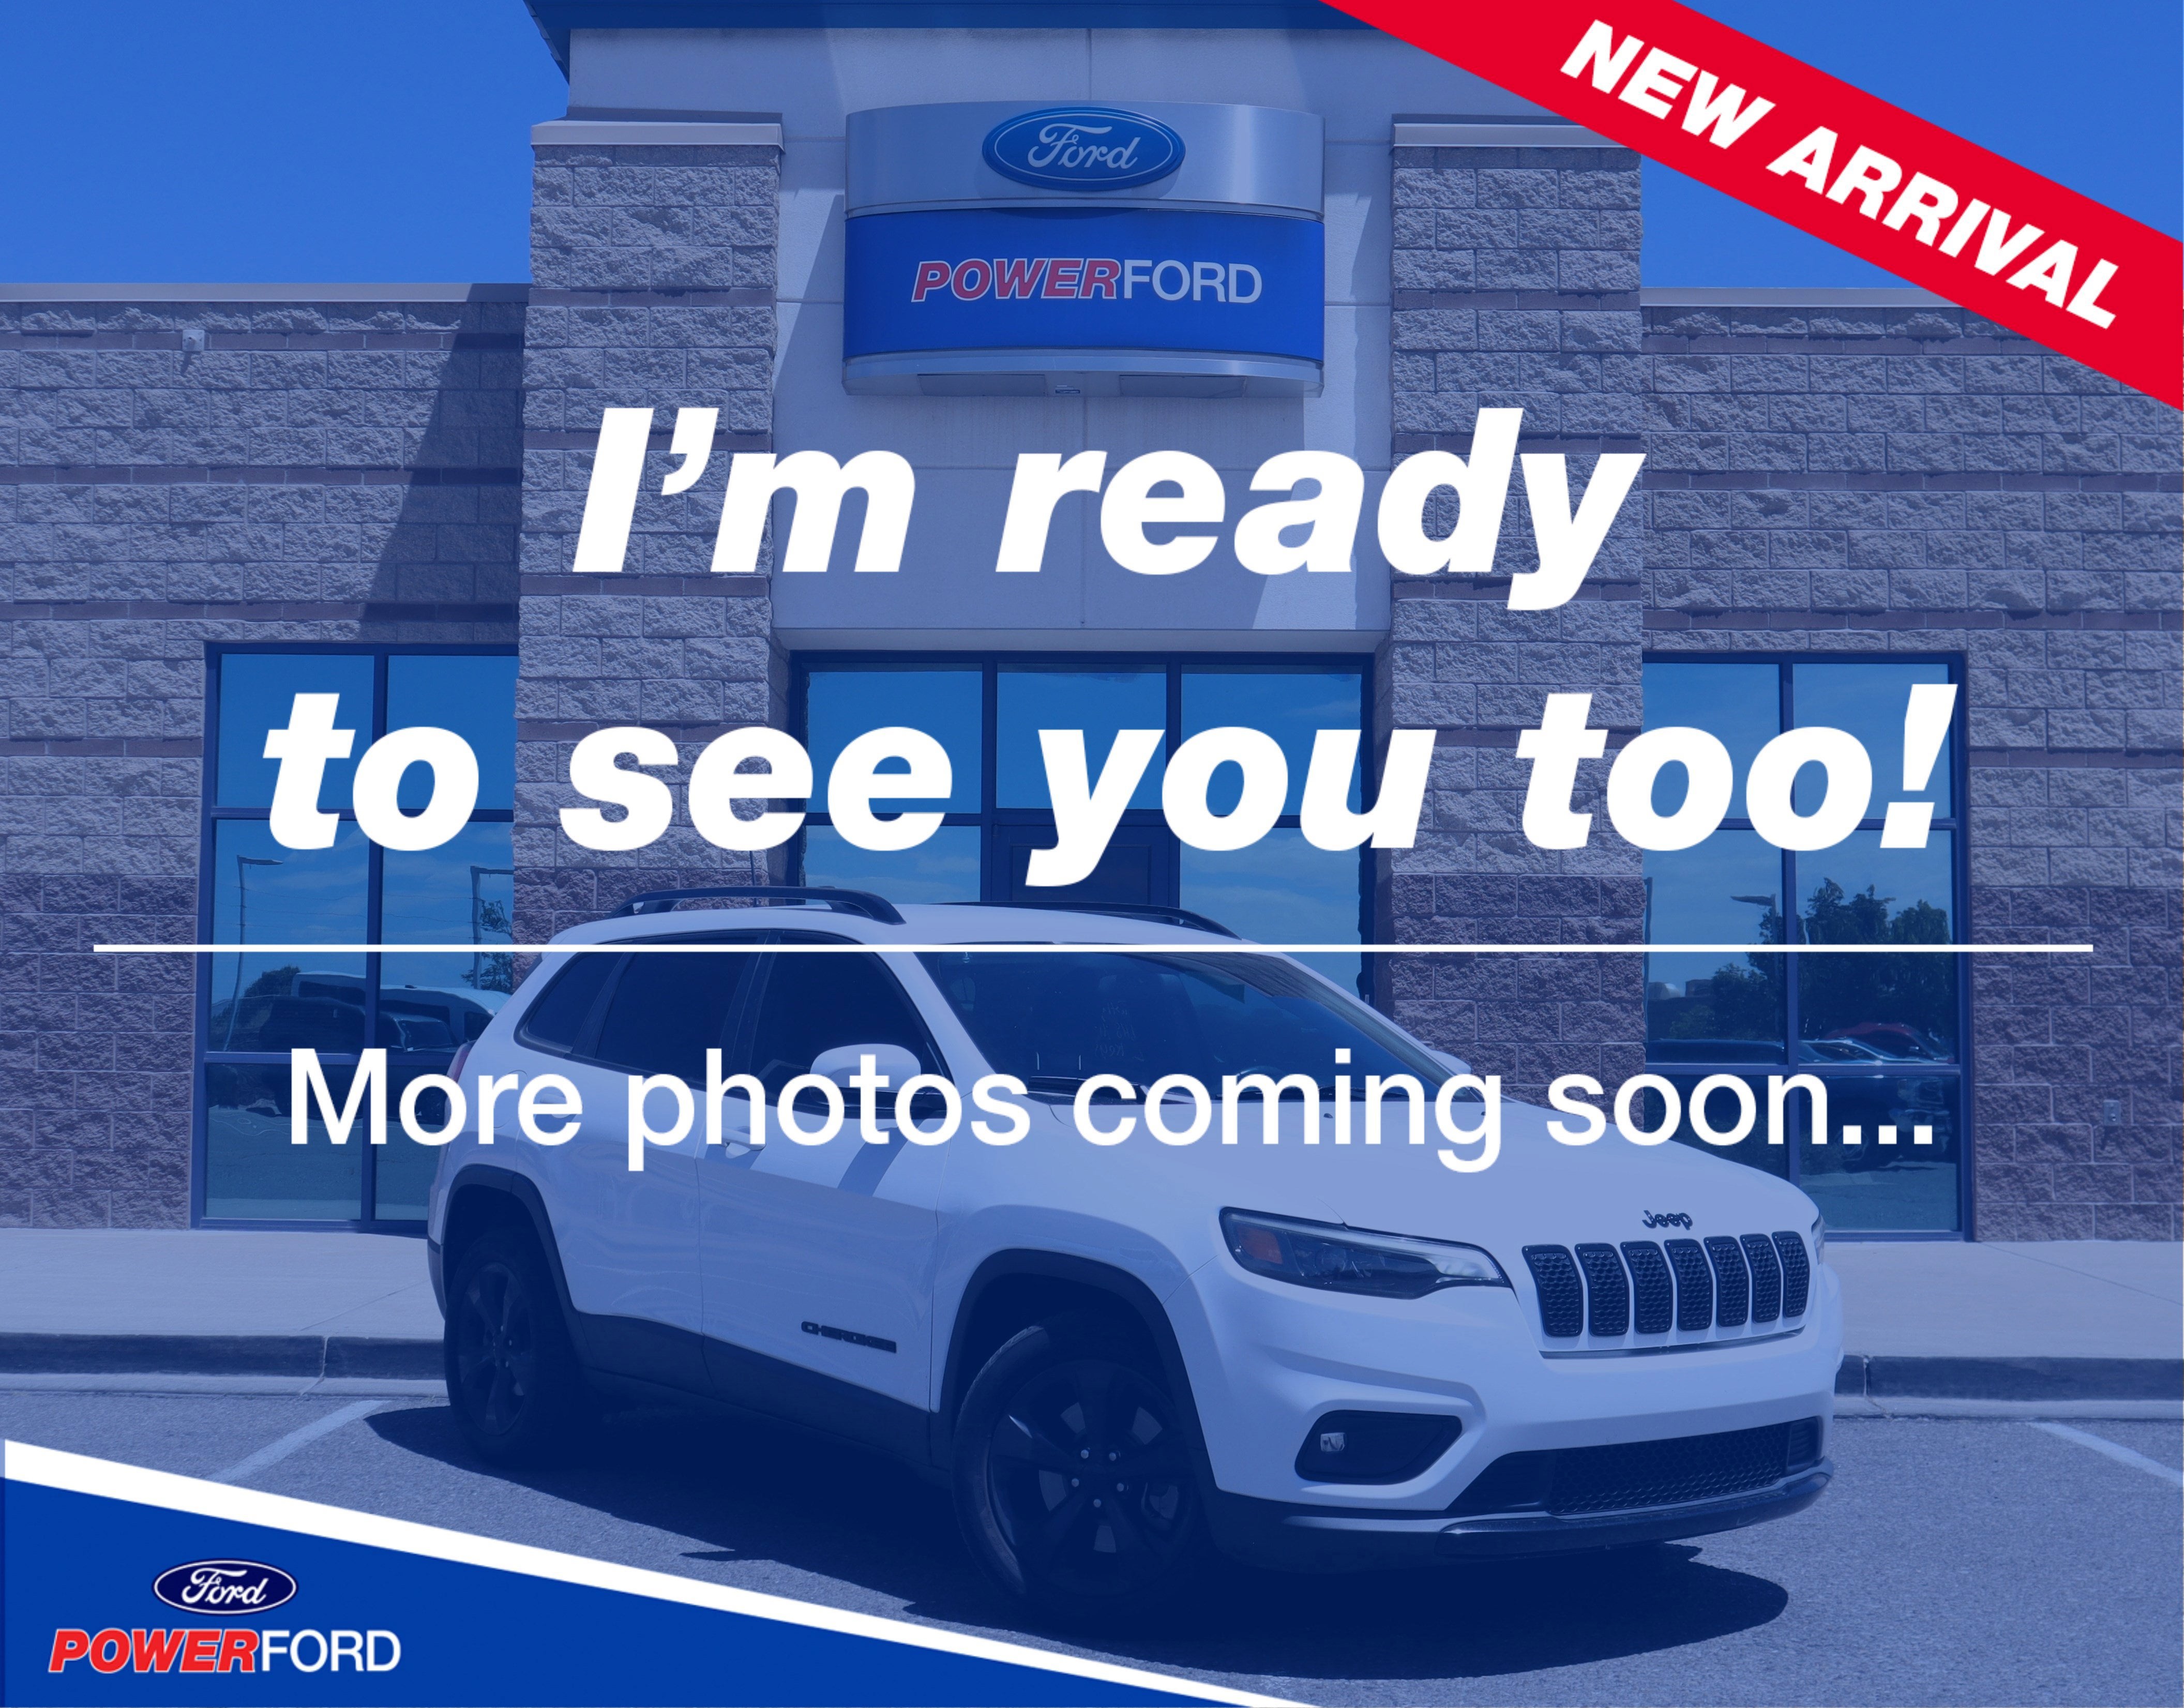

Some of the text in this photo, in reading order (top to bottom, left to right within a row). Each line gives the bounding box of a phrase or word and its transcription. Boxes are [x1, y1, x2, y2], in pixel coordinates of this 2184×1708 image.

[1028, 123, 1140, 170] Ford
[911, 258, 1262, 304] POWERFORD
[1641, 1210, 1693, 1230] Jeep
